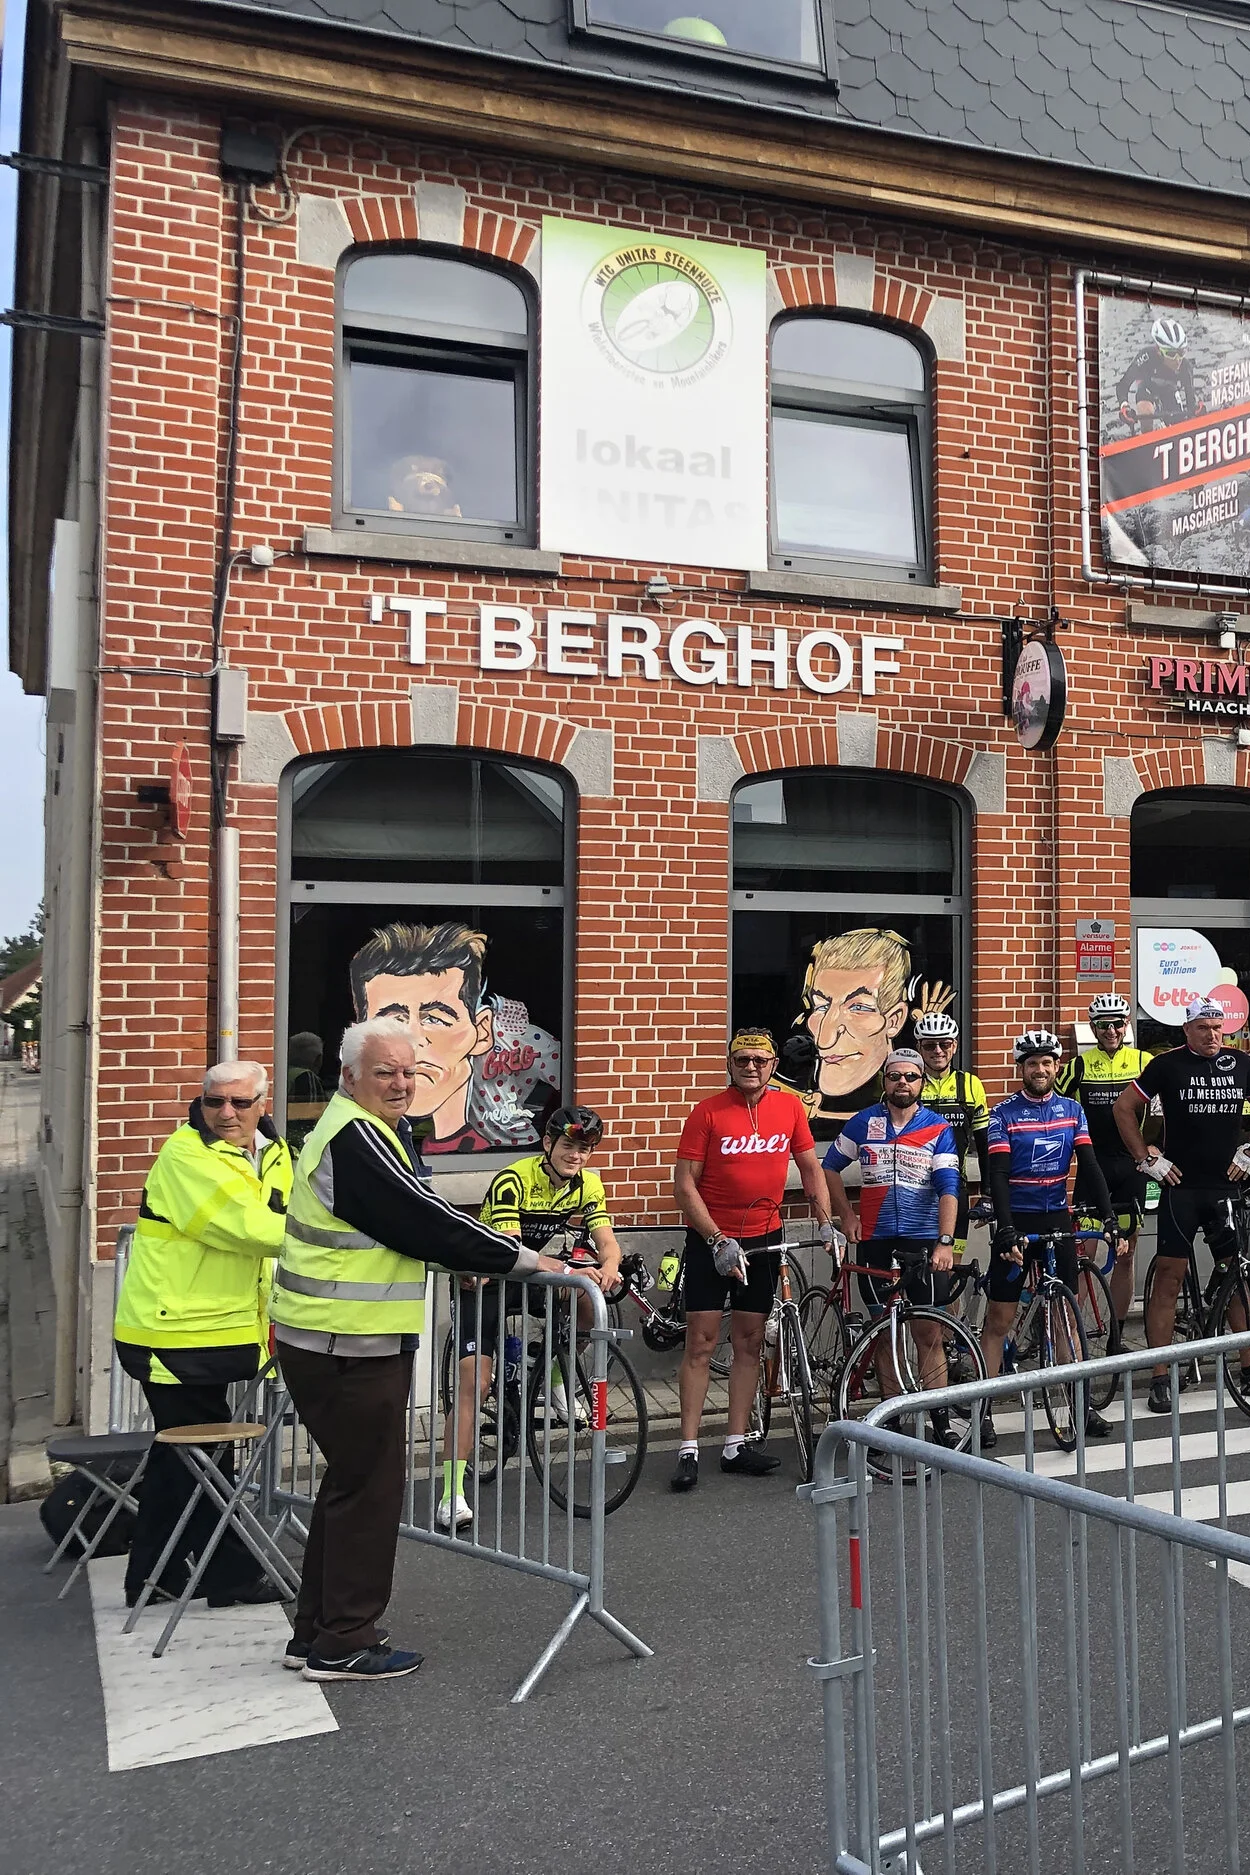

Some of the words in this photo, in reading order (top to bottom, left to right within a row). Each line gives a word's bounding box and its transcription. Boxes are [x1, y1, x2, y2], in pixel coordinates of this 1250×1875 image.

[594, 264, 615, 287] WTC
[616, 248, 656, 267] UNITAS
[664, 251, 722, 304] STEENHUIZE
[576, 428, 732, 479] lokaal
[578, 486, 750, 530] NITAS
[1193, 480, 1238, 509] LORENZO
[1172, 500, 1239, 536] MASCIARELLI
[370, 595, 448, 666] 'T
[479, 604, 904, 697] BERGHOF
[1080, 943, 1112, 952] Alarme
[1162, 967, 1197, 975] Millions
[1190, 1077, 1208, 1086] ALG.
[1211, 1076, 1235, 1087] BOUW
[721, 1133, 789, 1155] Wiel's
